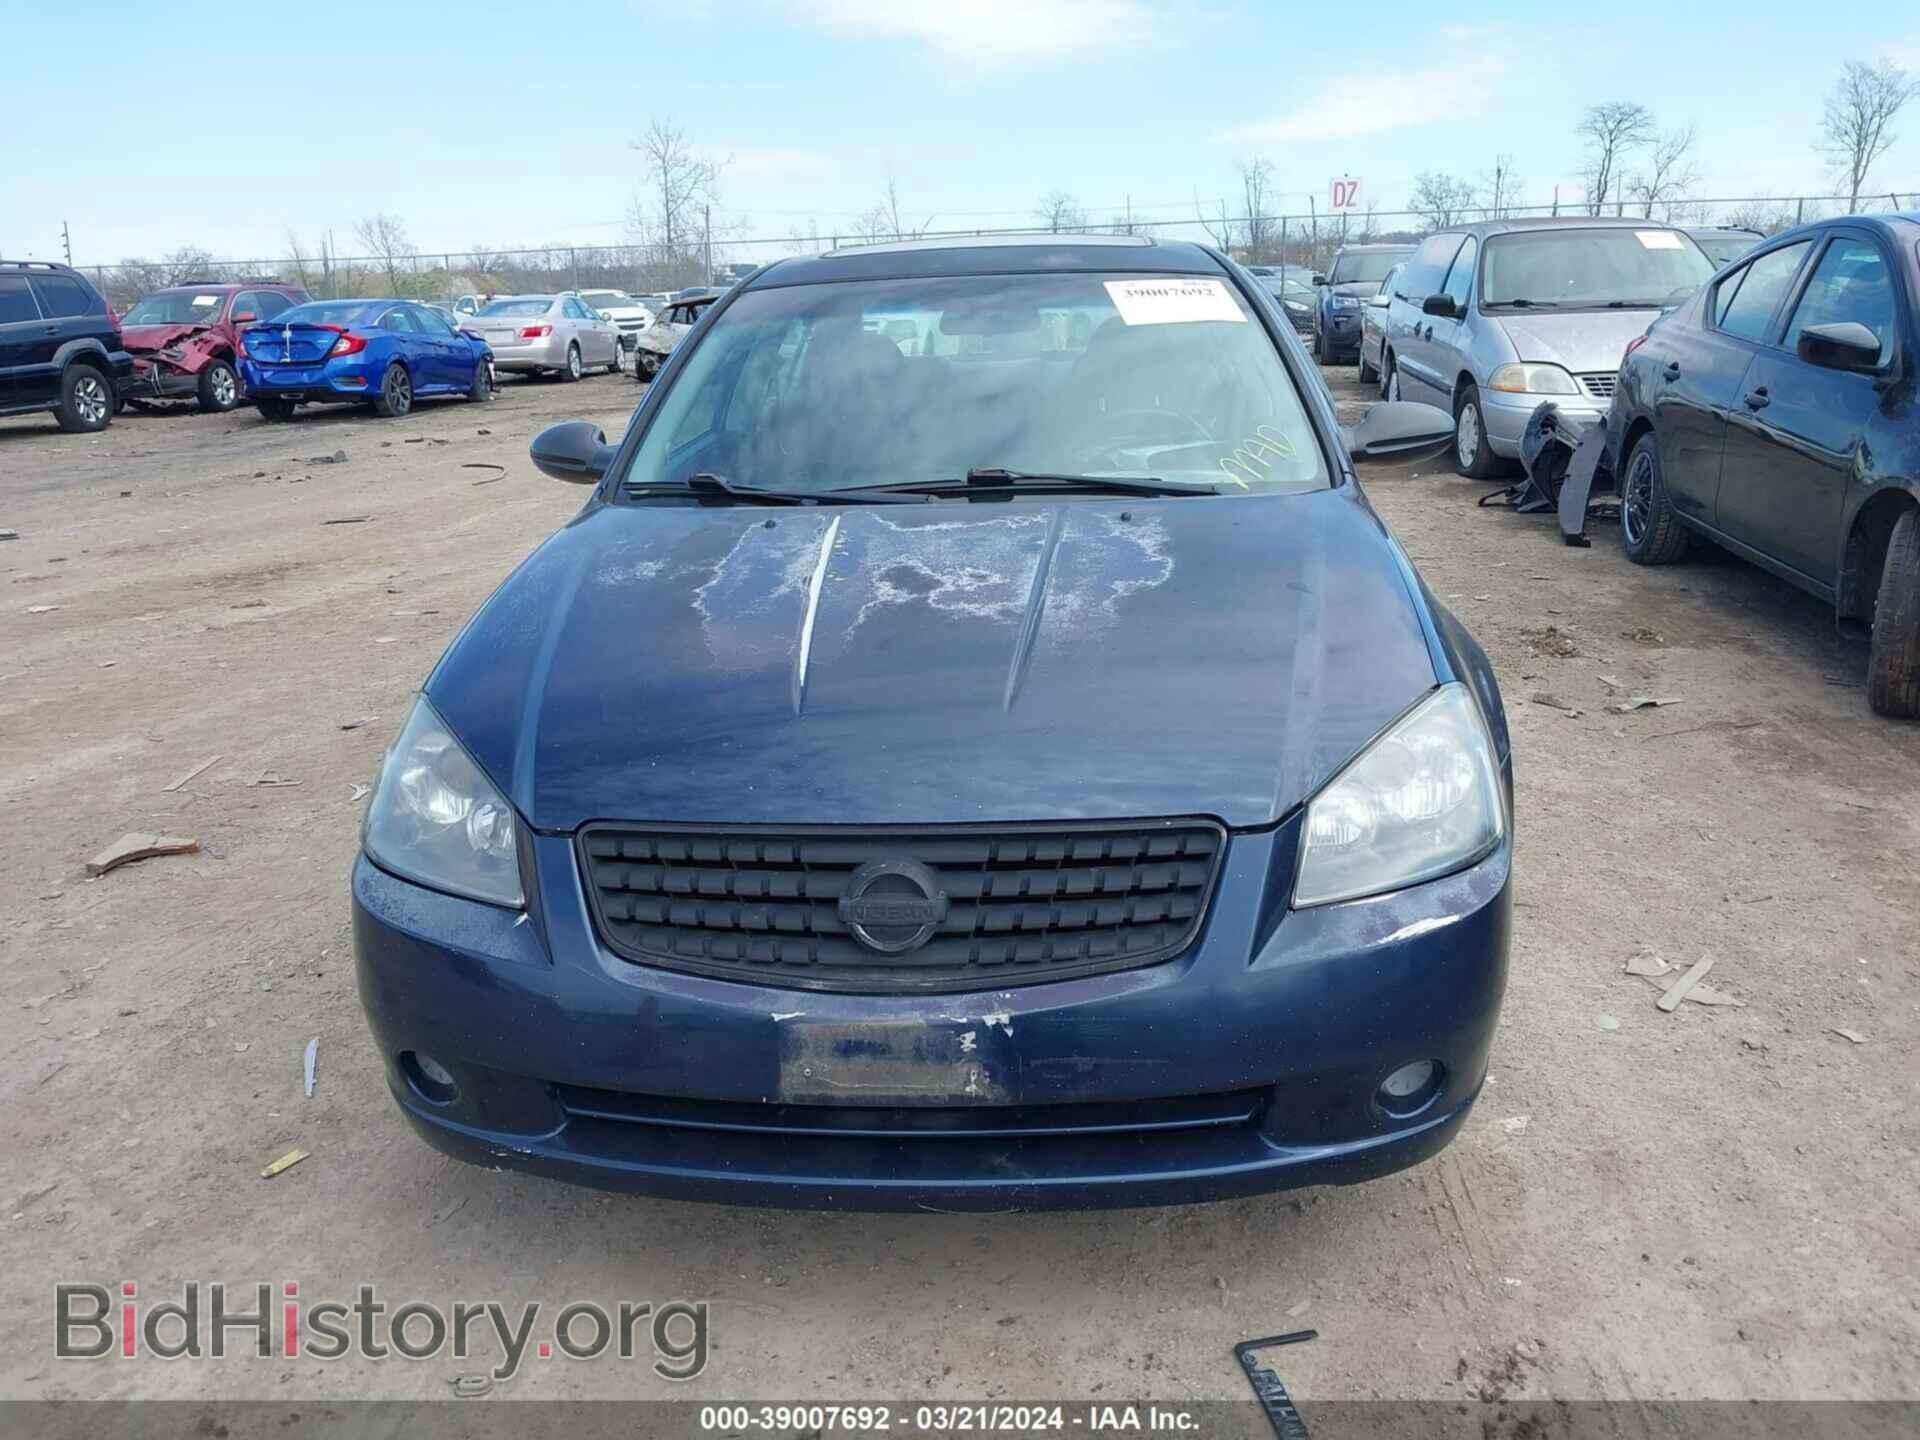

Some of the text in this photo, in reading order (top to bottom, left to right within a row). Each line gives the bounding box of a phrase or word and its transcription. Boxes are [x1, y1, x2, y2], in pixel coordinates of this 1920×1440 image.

[1334, 181, 1358, 207] DZ
[1124, 287, 1215, 297] 39007692
[849, 902, 935, 921] NISSAN
